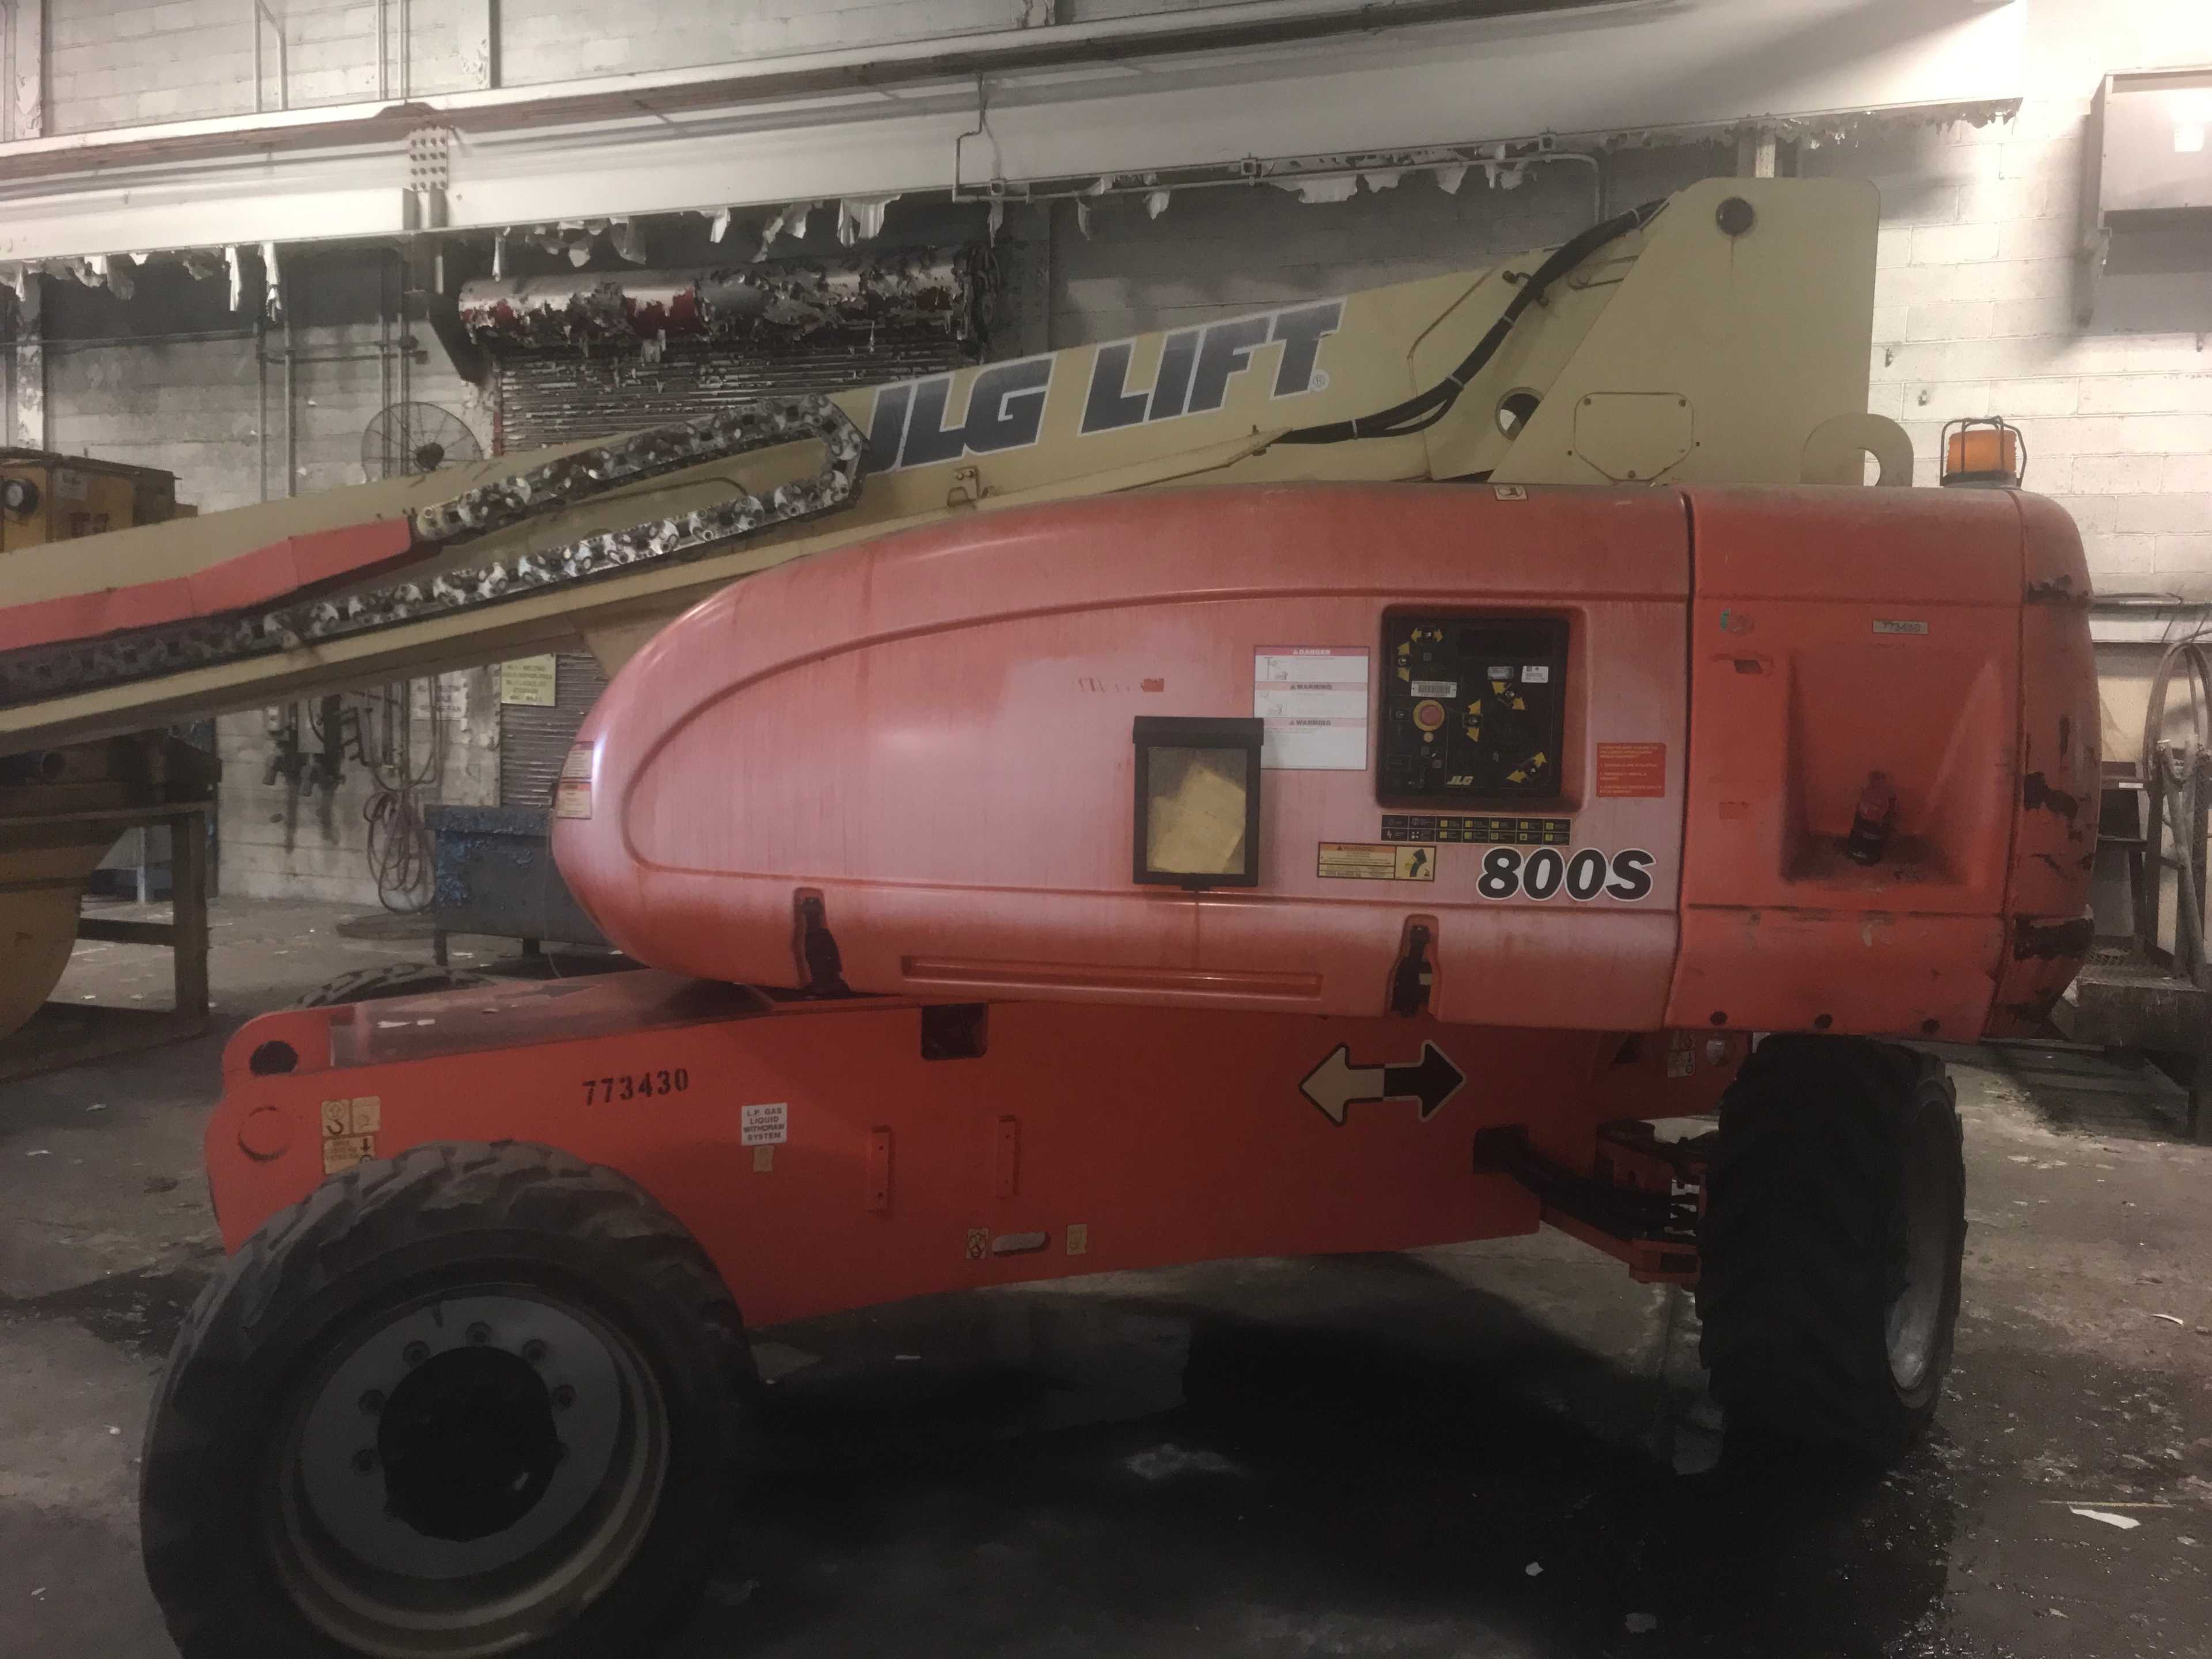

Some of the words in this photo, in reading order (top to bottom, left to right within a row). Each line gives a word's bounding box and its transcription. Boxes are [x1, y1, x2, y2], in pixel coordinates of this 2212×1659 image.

[1077, 297, 1347, 437] LIFT
[1446, 775, 1474, 786] JLG
[1476, 845, 1656, 902] 800S
[582, 1068, 688, 1106] 773430
[764, 1107, 782, 1115] GAS
[749, 1116, 779, 1125] LIQUID
[747, 1132, 781, 1141] SYSTEM
